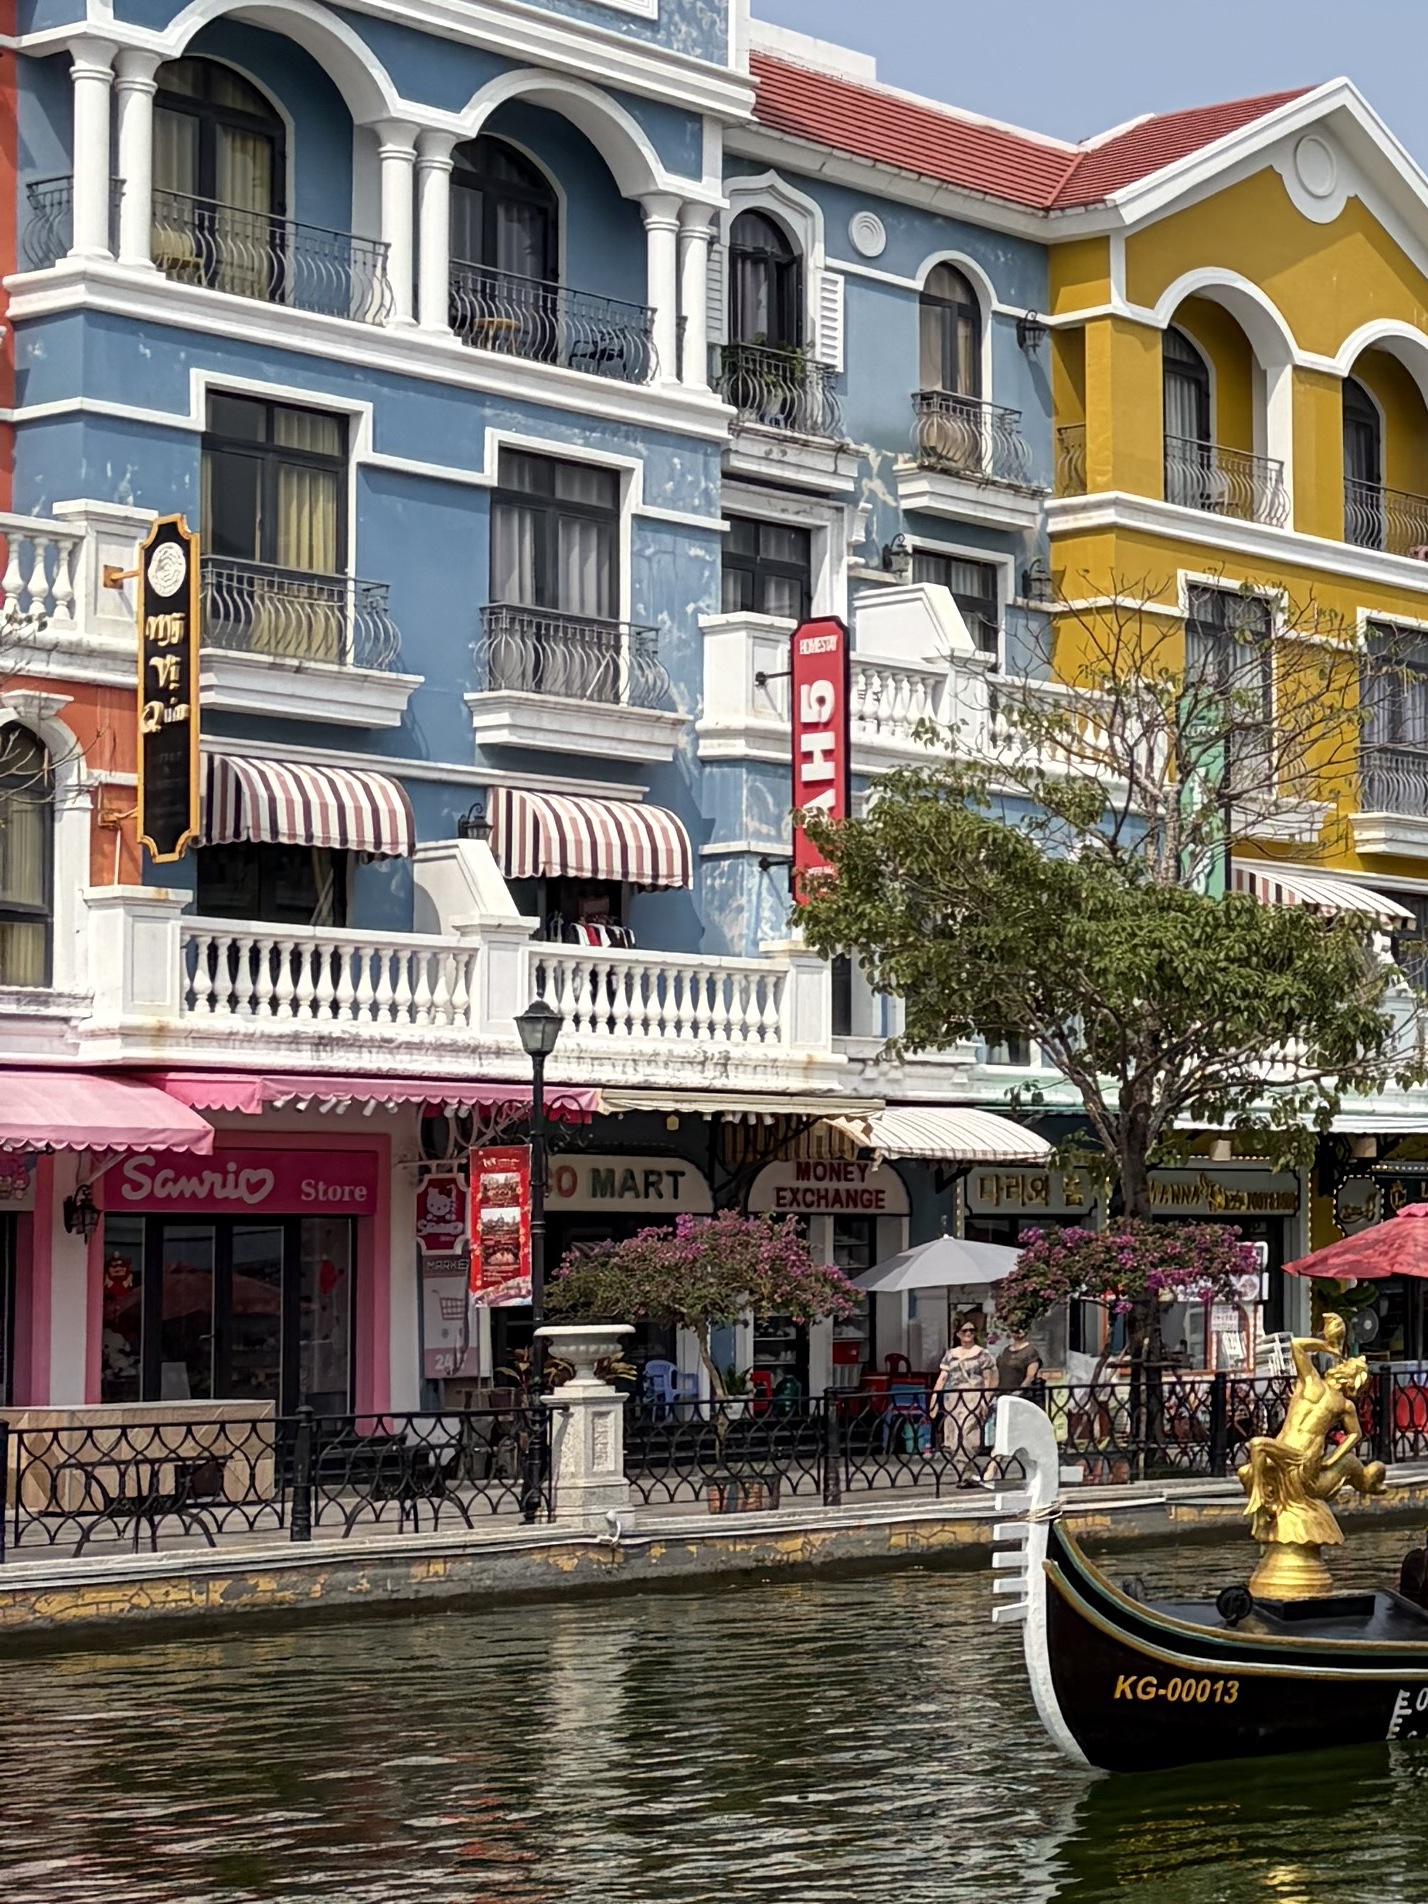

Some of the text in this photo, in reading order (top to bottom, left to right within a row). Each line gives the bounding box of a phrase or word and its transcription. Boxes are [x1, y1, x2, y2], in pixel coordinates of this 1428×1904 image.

[121, 1155, 367, 1205] Sanrio Store
[591, 1167, 686, 1200] MART
[795, 1159, 869, 1183] MONEY
[773, 1185, 887, 1210] EXCHANGE
[1113, 1675, 1240, 1704] KG-00013
